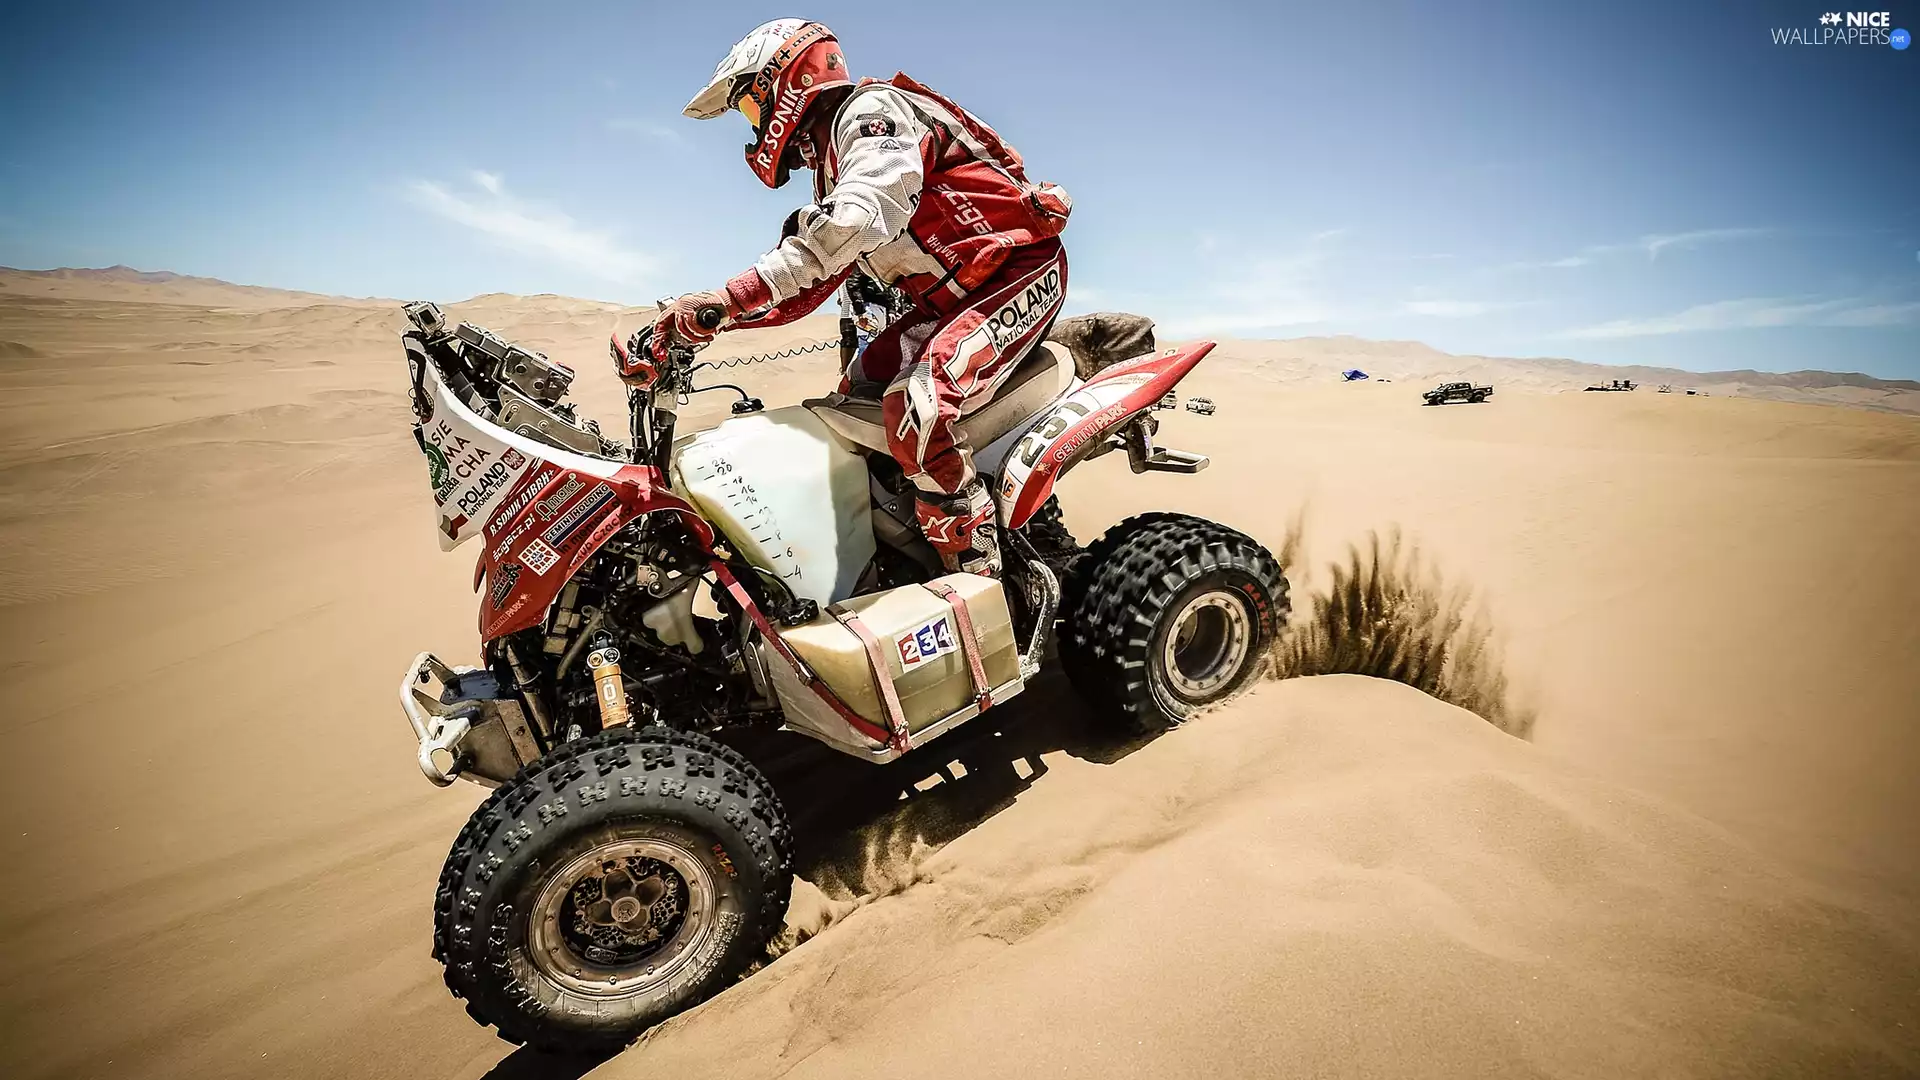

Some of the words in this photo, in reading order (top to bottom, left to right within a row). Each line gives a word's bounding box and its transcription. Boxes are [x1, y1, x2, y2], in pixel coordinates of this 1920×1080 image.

[765, 81, 802, 150] SONIK
[757, 152, 774, 170] R.
[986, 268, 1059, 341] POLAND
[996, 314, 1039, 350] NATIONAL
[1039, 290, 1060, 314] TEAM
[431, 419, 452, 447] SIE
[1052, 420, 1101, 463] GEMINI
[1096, 401, 1128, 430] PARK
[443, 435, 471, 464] MA
[455, 447, 491, 478] CHA
[717, 464, 732, 475] 20
[733, 476, 743, 485] 18
[457, 462, 506, 512] POLAND
[466, 490, 496, 518] NATIONAL
[492, 472, 511, 490] TEAM
[741, 485, 755, 495] 16
[544, 513, 573, 542] GEMINI
[572, 484, 609, 517] HOLDING
[786, 547, 793, 557] 6
[794, 564, 803, 580] 4
[505, 600, 524, 618] PARK
